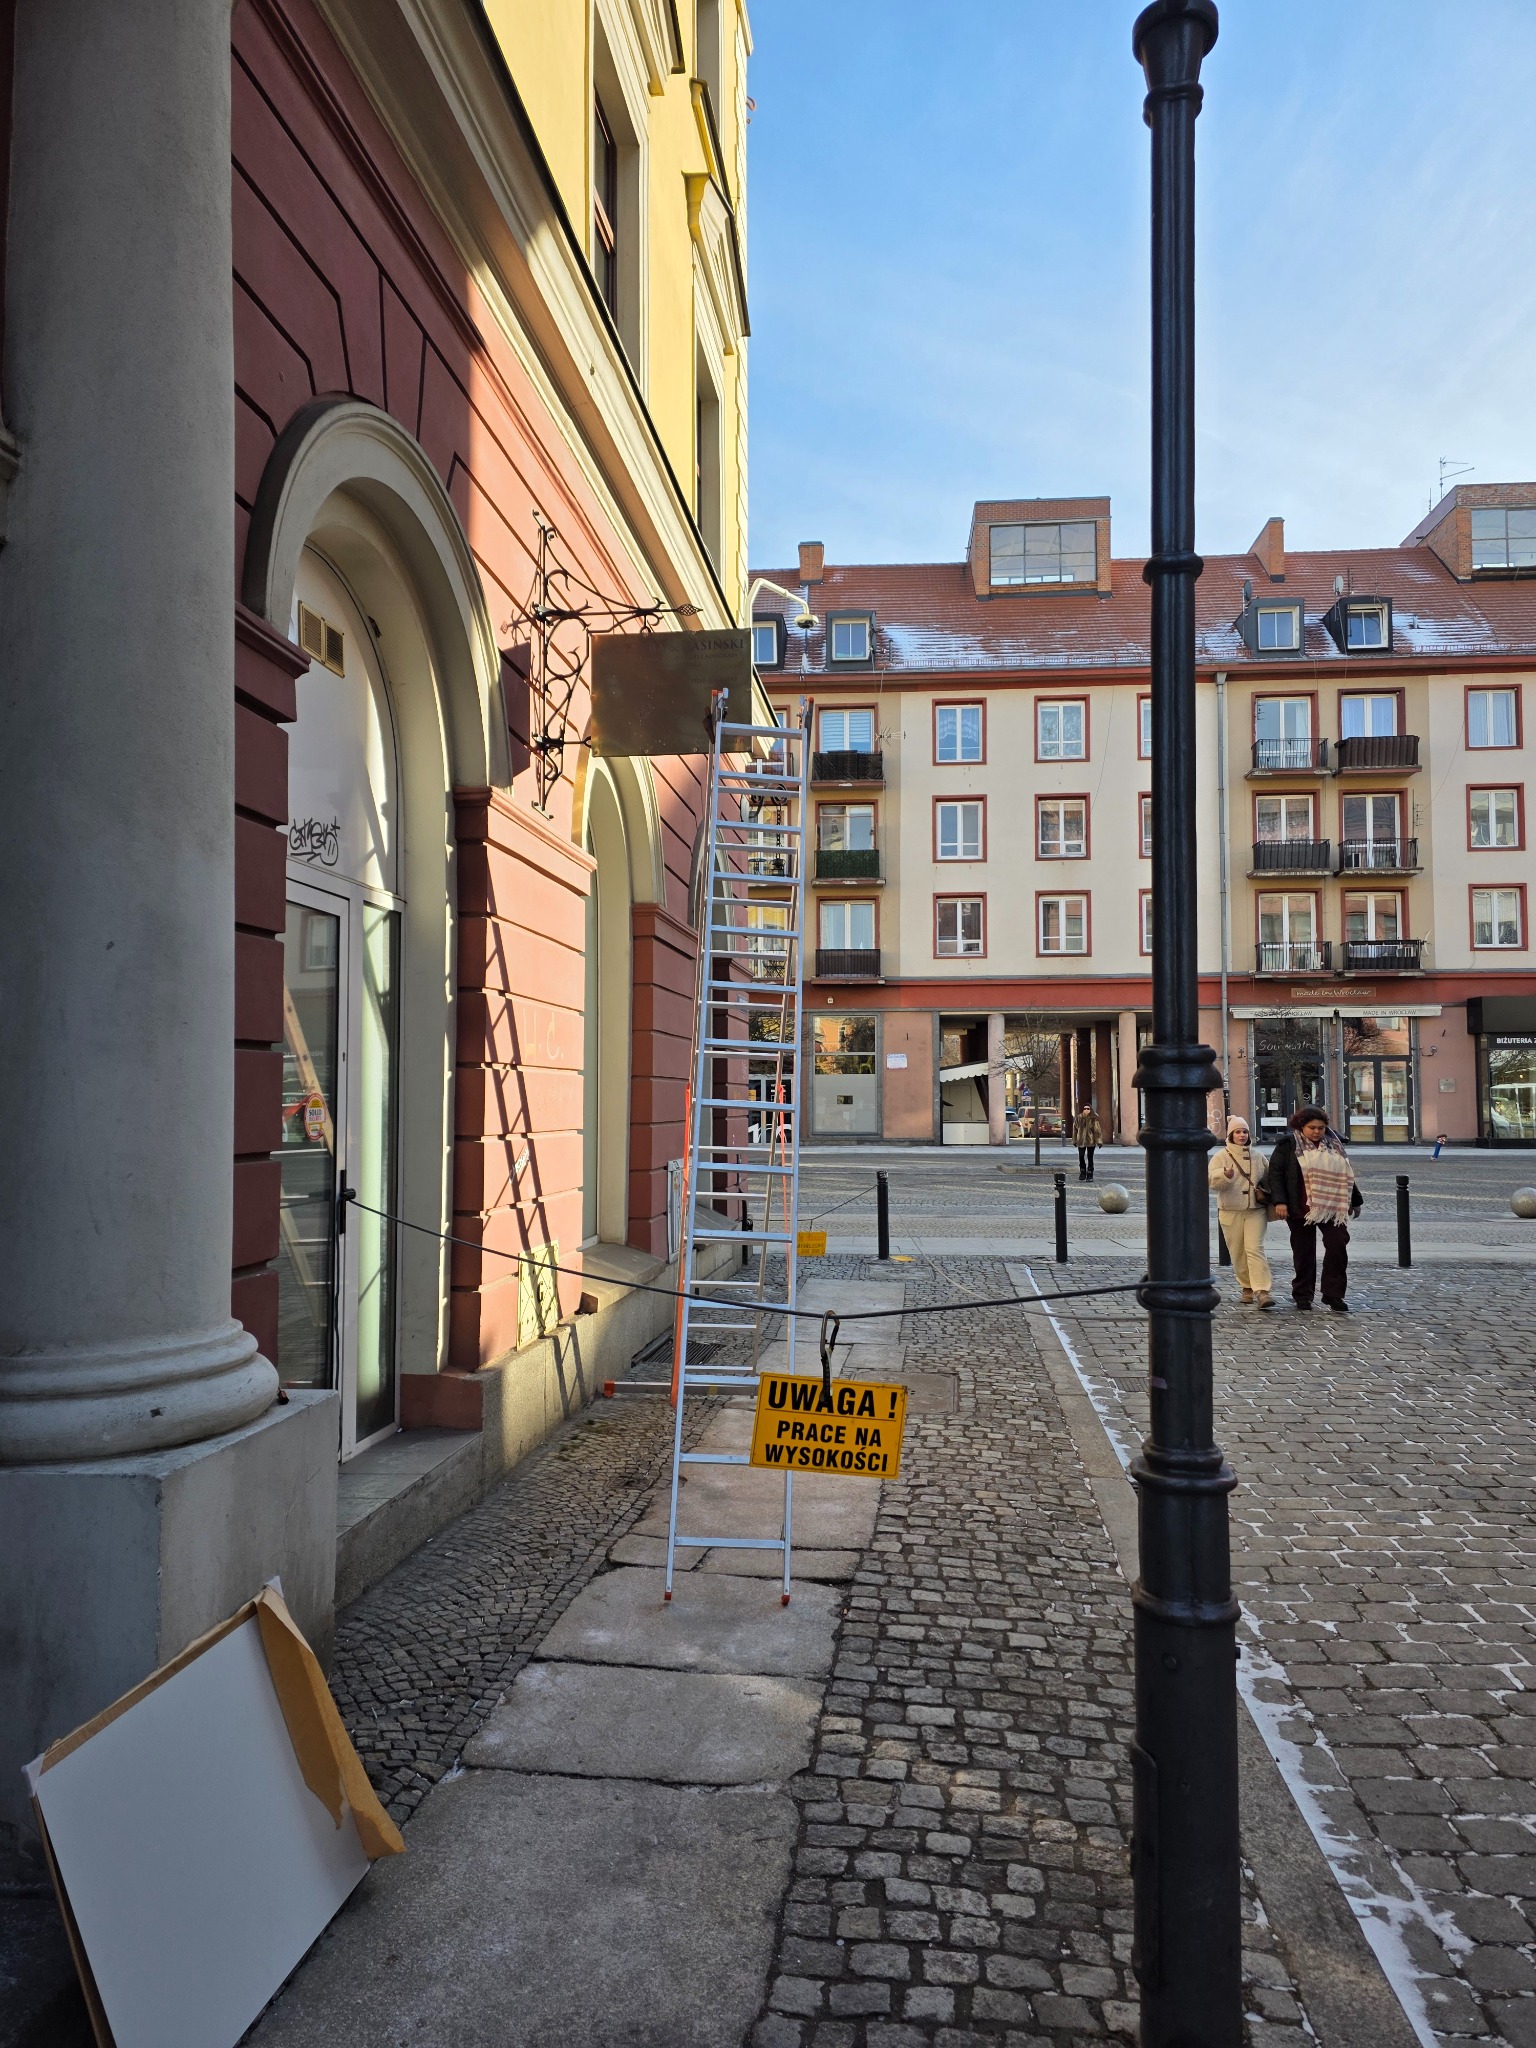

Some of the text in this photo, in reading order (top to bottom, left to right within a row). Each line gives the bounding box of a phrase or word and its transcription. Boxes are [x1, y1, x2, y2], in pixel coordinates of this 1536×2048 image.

[1496, 1036, 1533, 1044] BIŻUTERIA
[888, 1391, 898, 1419] !
[776, 1420, 882, 1447] PRACE NA
[765, 1443, 888, 1472] WYSOKOŚCI
